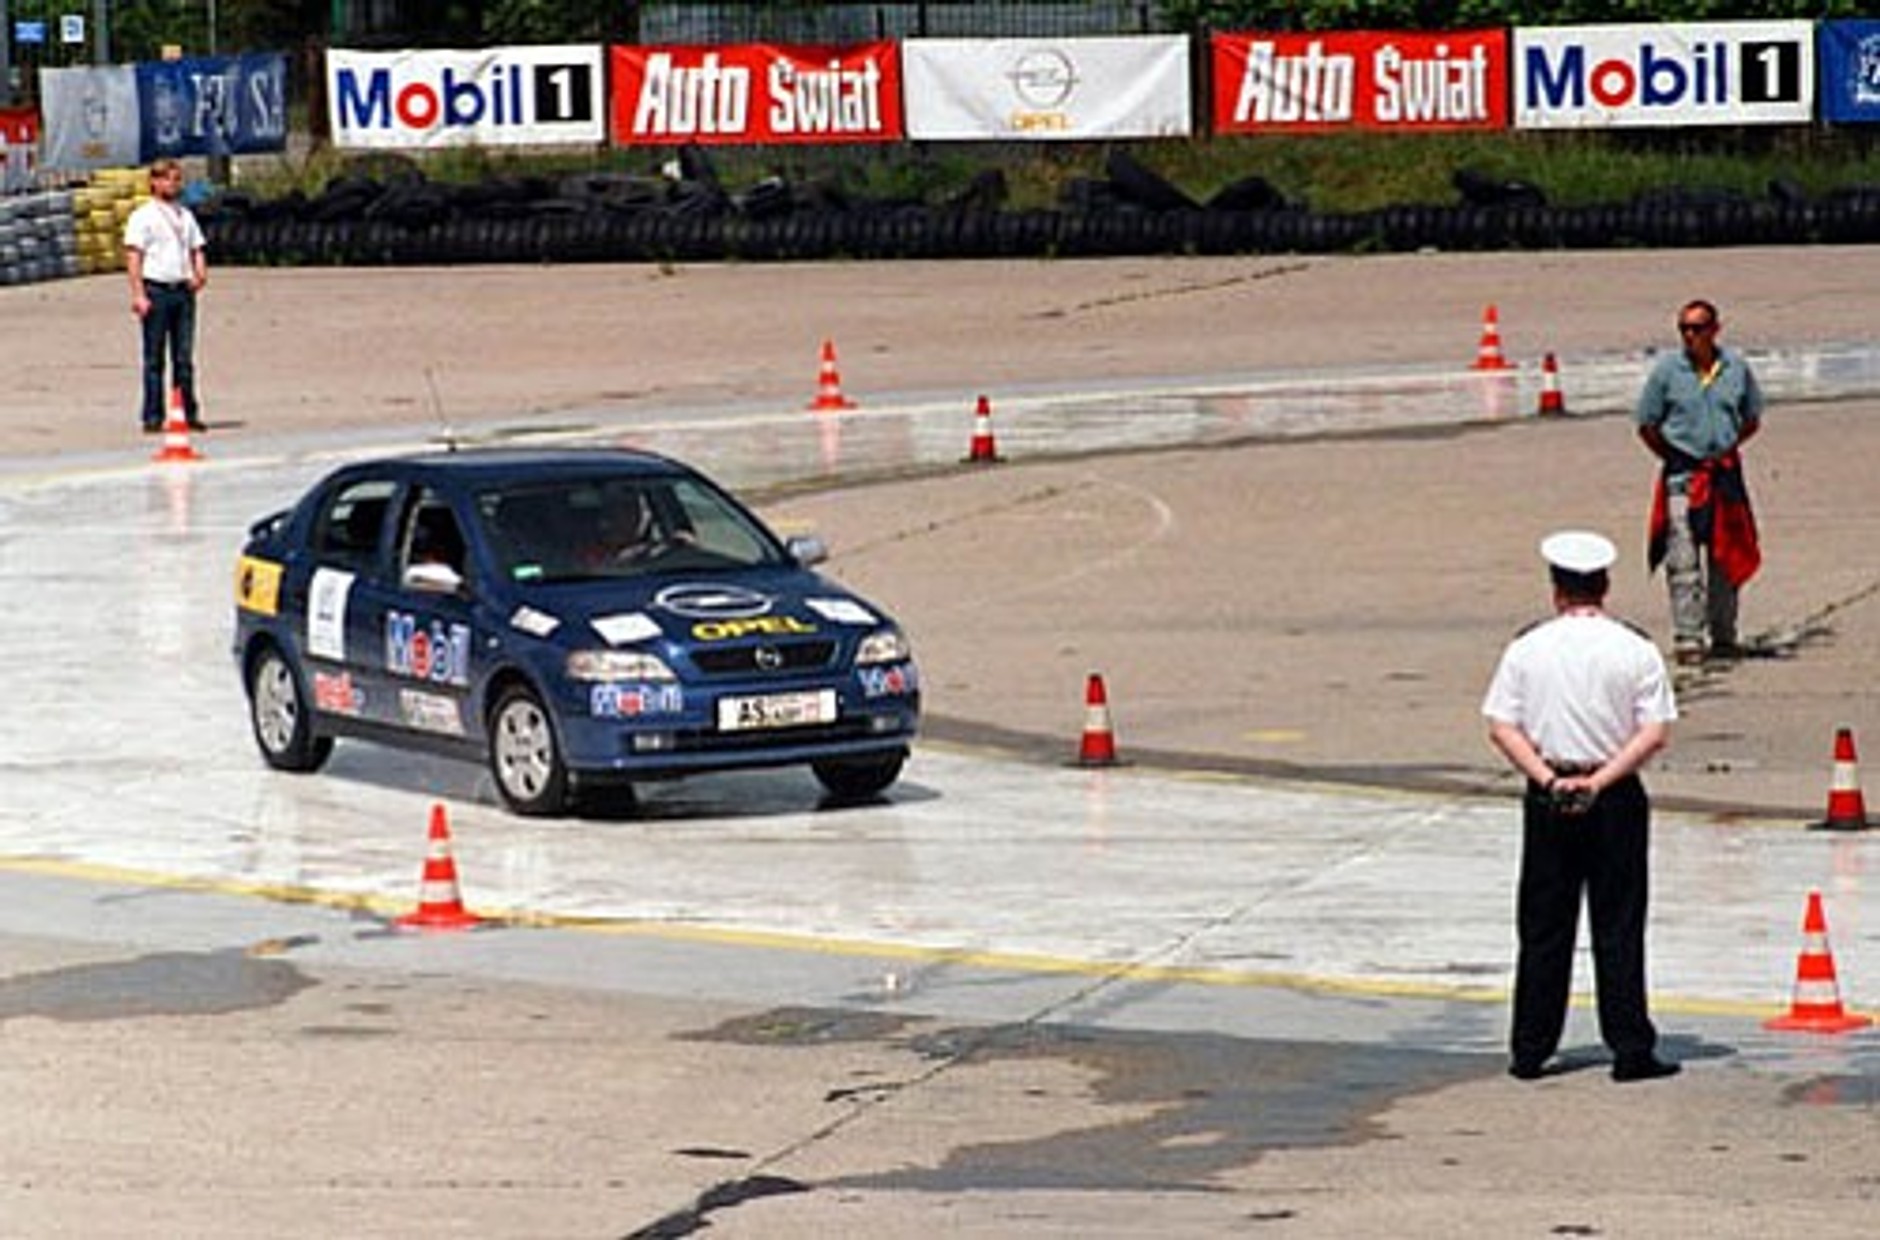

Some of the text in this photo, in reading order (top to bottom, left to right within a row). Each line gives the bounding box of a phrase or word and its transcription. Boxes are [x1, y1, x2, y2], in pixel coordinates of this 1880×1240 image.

[337, 64, 574, 129] Mobil 1
[632, 52, 750, 134] Auto
[1233, 41, 1354, 121] Auto
[1525, 42, 1781, 109] Mobil 1
[692, 616, 817, 640] OPEL
